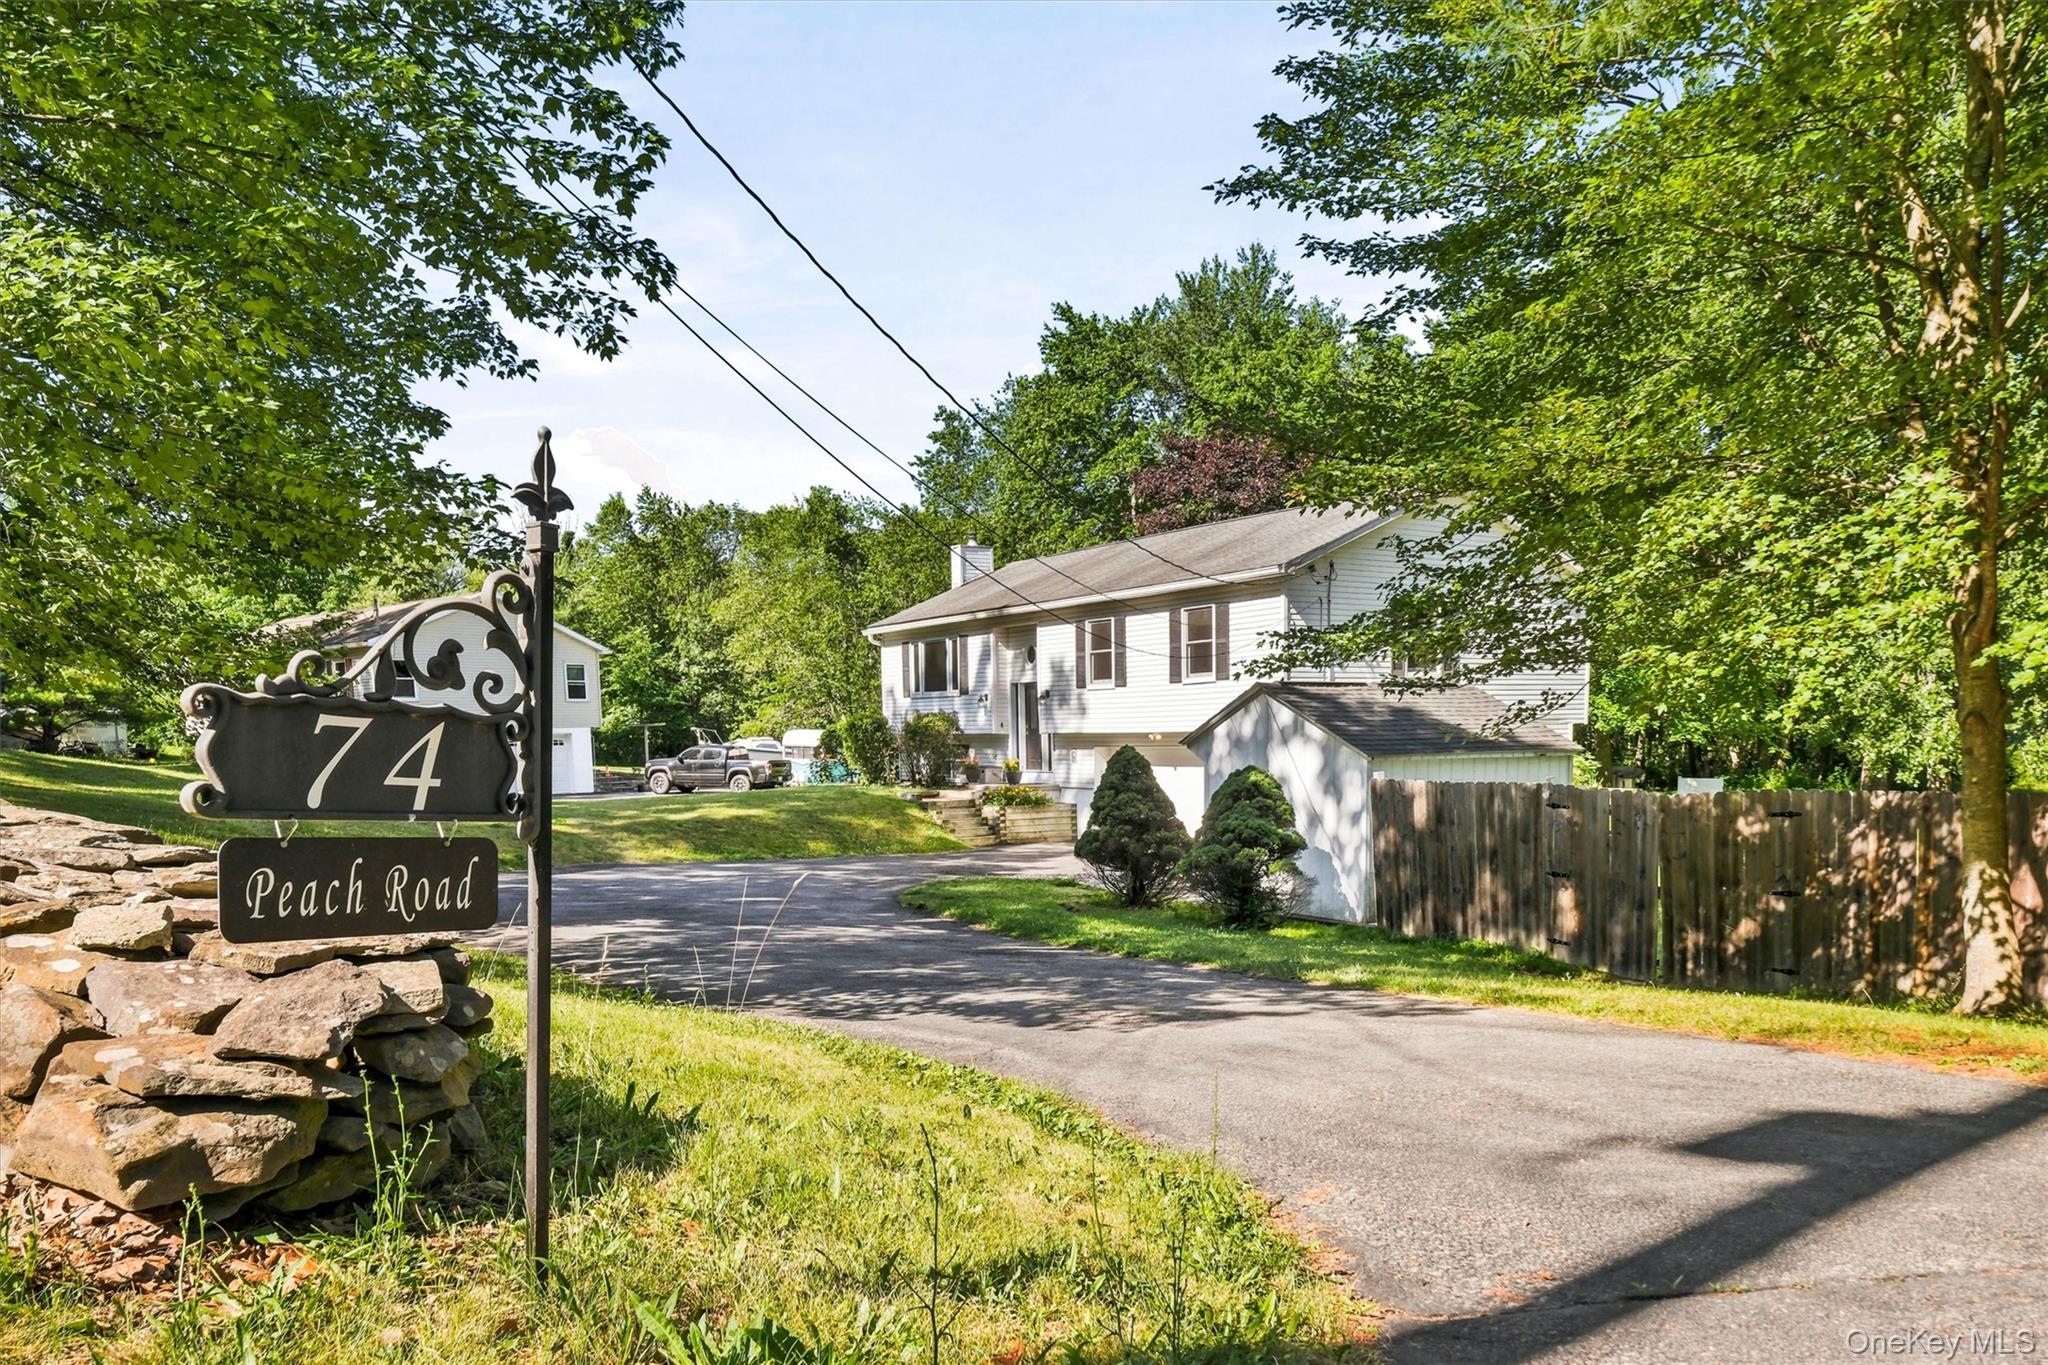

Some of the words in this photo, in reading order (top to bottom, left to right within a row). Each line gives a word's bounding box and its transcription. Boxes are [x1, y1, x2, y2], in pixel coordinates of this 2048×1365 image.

[306, 713, 446, 811] 74
[245, 856, 364, 920] Peach
[384, 855, 480, 923] Road
